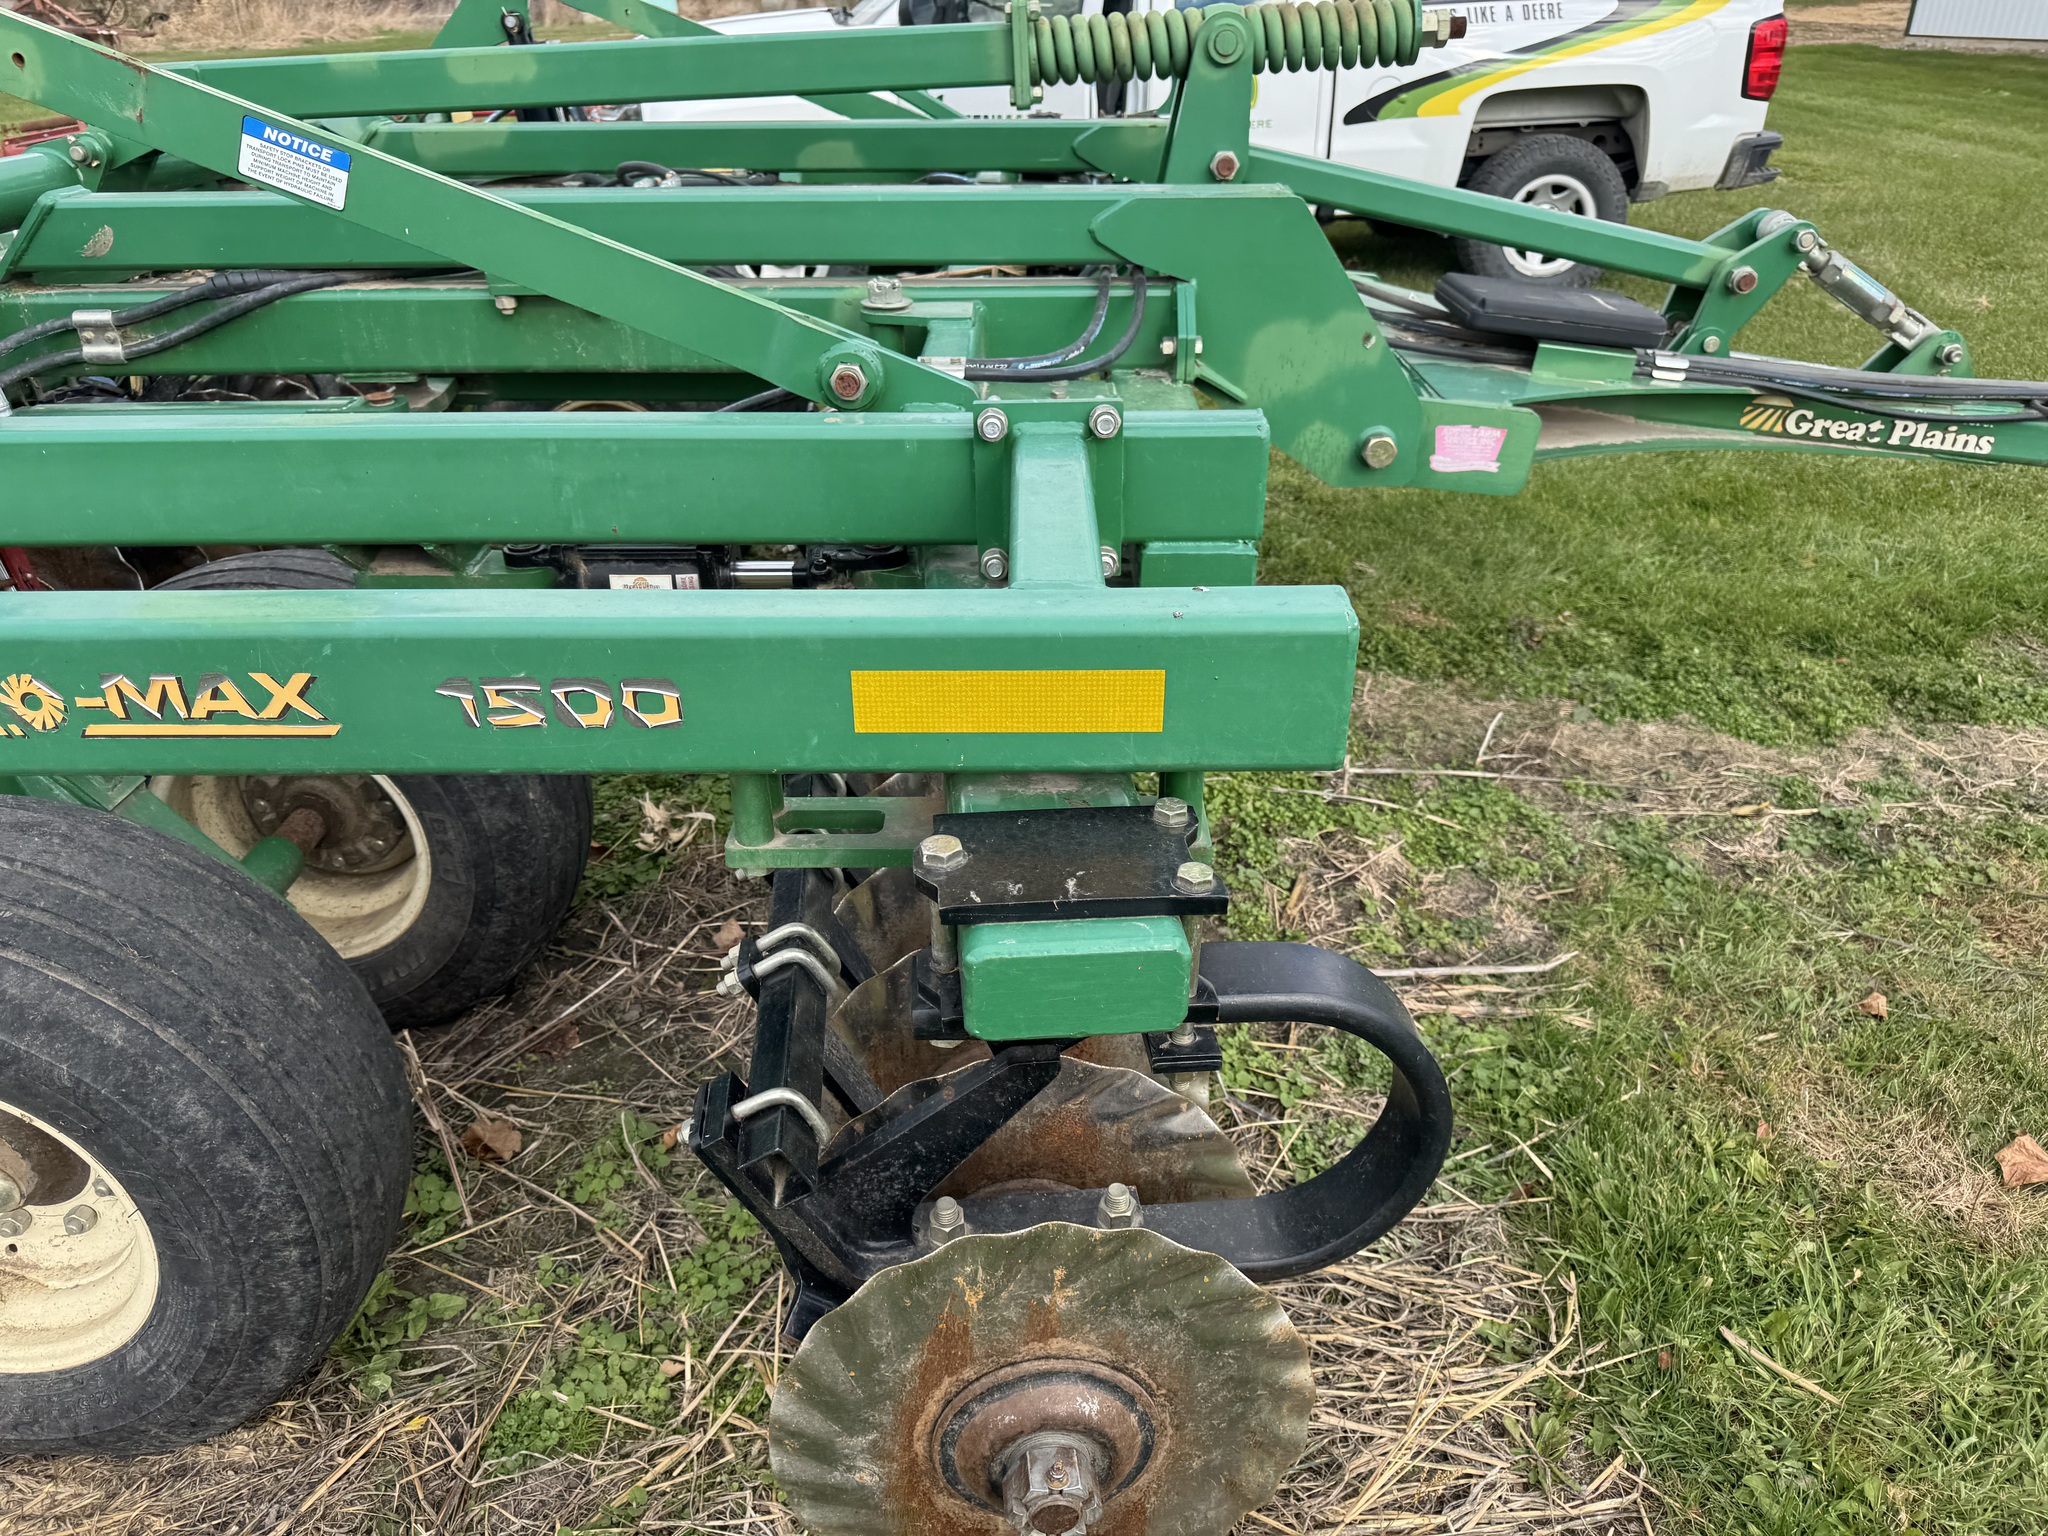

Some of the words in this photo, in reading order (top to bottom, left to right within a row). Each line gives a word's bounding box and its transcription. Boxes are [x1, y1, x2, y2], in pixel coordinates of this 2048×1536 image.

[1467, 6, 1497, 24] LIKE
[1506, 5, 1514, 22] A
[1522, 2, 1564, 21] DEERE
[259, 142, 278, 153] SAFETY
[279, 150, 293, 159] STOP
[294, 155, 321, 169] BRACKETS
[263, 126, 333, 162] NOTICE
[246, 143, 275, 158] TRANSPORT
[277, 155, 290, 164] LOCK
[292, 160, 304, 169] PINS
[305, 165, 319, 174] MUST
[328, 174, 342, 183] USED
[247, 166, 257, 174] THE
[258, 170, 274, 180] EVENT
[283, 180, 312, 194] HYDRAULIC
[250, 162, 274, 175] SUPPORT
[275, 171, 294, 182] WEIGHT
[304, 182, 327, 194] MACHINE
[251, 151, 270, 162] DURING
[272, 159, 302, 174] TRANSPORT
[311, 173, 335, 186] MAINTAIN
[253, 157, 276, 169] MINIMUM
[277, 166, 300, 179] MACHINE
[301, 175, 320, 186] HEIGHT
[321, 183, 332, 191] AND
[1784, 409, 1885, 442] Great
[1887, 420, 1995, 455] Plains
[435, 678, 685, 728] 1500
